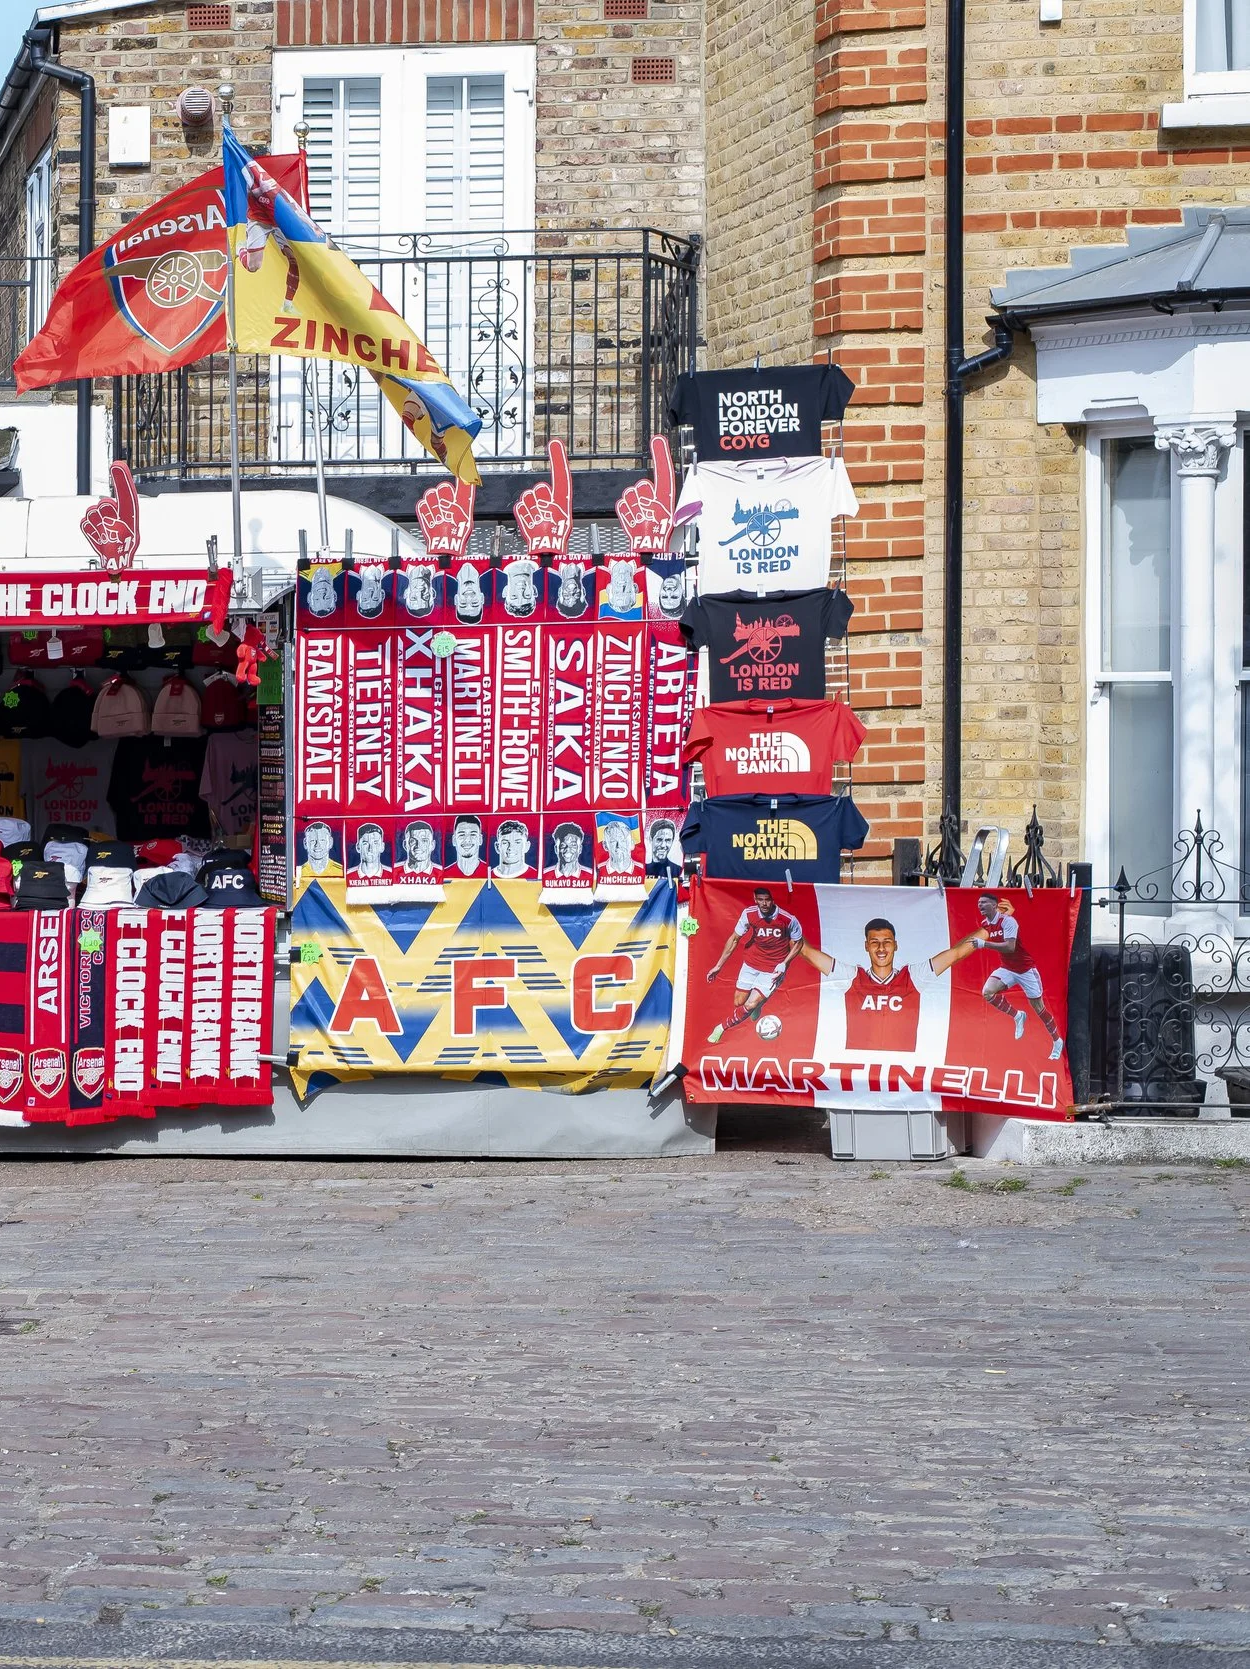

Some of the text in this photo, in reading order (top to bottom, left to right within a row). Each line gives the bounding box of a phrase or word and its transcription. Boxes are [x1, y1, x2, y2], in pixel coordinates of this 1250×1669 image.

[718, 389, 782, 407] NORTH
[718, 403, 798, 422] LONDON
[719, 418, 800, 436] FOREVER
[719, 434, 770, 450] COYG
[451, 521, 466, 536] #1
[551, 519, 568, 536] #1
[652, 518, 669, 535] #1
[117, 537, 131, 554] #1
[431, 536, 461, 551] FAN
[531, 536, 562, 550] FAN
[633, 536, 664, 550] FAN
[729, 545, 799, 561] LONDON
[736, 560, 791, 574] IS RED
[41, 580, 141, 616] CLOCK
[150, 578, 209, 615] END
[437, 645, 450, 653] £15
[729, 663, 799, 678] LONDON
[737, 676, 792, 692] IS RED
[306, 639, 334, 800] RAMSDALE
[333, 677, 343, 762] AARON
[355, 643, 382, 798] TIERNEY
[383, 677, 392, 762] KIERAN
[404, 628, 433, 812] XHAKA
[434, 677, 442, 762] GRANIT
[454, 638, 482, 801] MARTINELLI
[482, 676, 492, 762] GABRIEL
[500, 629, 532, 808] SMITH-ROWE
[530, 680, 540, 757] EMILE
[554, 639, 584, 802] SAKA
[583, 677, 593, 764] BUKAYO
[601, 634, 632, 799] ZINCHENKO
[631, 673, 642, 761] OLEKSANDR
[652, 641, 687, 796] ARTETA
[749, 732, 781, 747] THE
[725, 747, 781, 761] NORTH
[737, 760, 782, 774] BANK
[44, 800, 98, 812] LONDON
[138, 803, 195, 814] LONDON
[49, 810, 92, 823] IS RED
[144, 813, 190, 825] IS RED
[756, 819, 789, 834] THE
[732, 833, 789, 848] NORTH
[743, 847, 789, 861] BANK
[211, 873, 244, 890] AFC
[370, 878, 392, 886] TIERNEY
[400, 876, 436, 884] XHAKA
[545, 879, 590, 887] BUKAYO SAKA
[600, 876, 642, 884] ZINCHENKO
[682, 921, 696, 931] £20
[757, 928, 782, 938] AFC
[190, 909, 223, 1079] NORTH BANK
[230, 909, 265, 1079] NORTH BANK
[327, 953, 637, 1037] AFC
[156, 930, 186, 1083] CLOCK END
[860, 994, 903, 1012] AFC
[114, 938, 147, 1091] CLOCK END
[34, 1056, 61, 1068] Arsenal
[699, 1056, 1058, 1109] MARTINELLI
